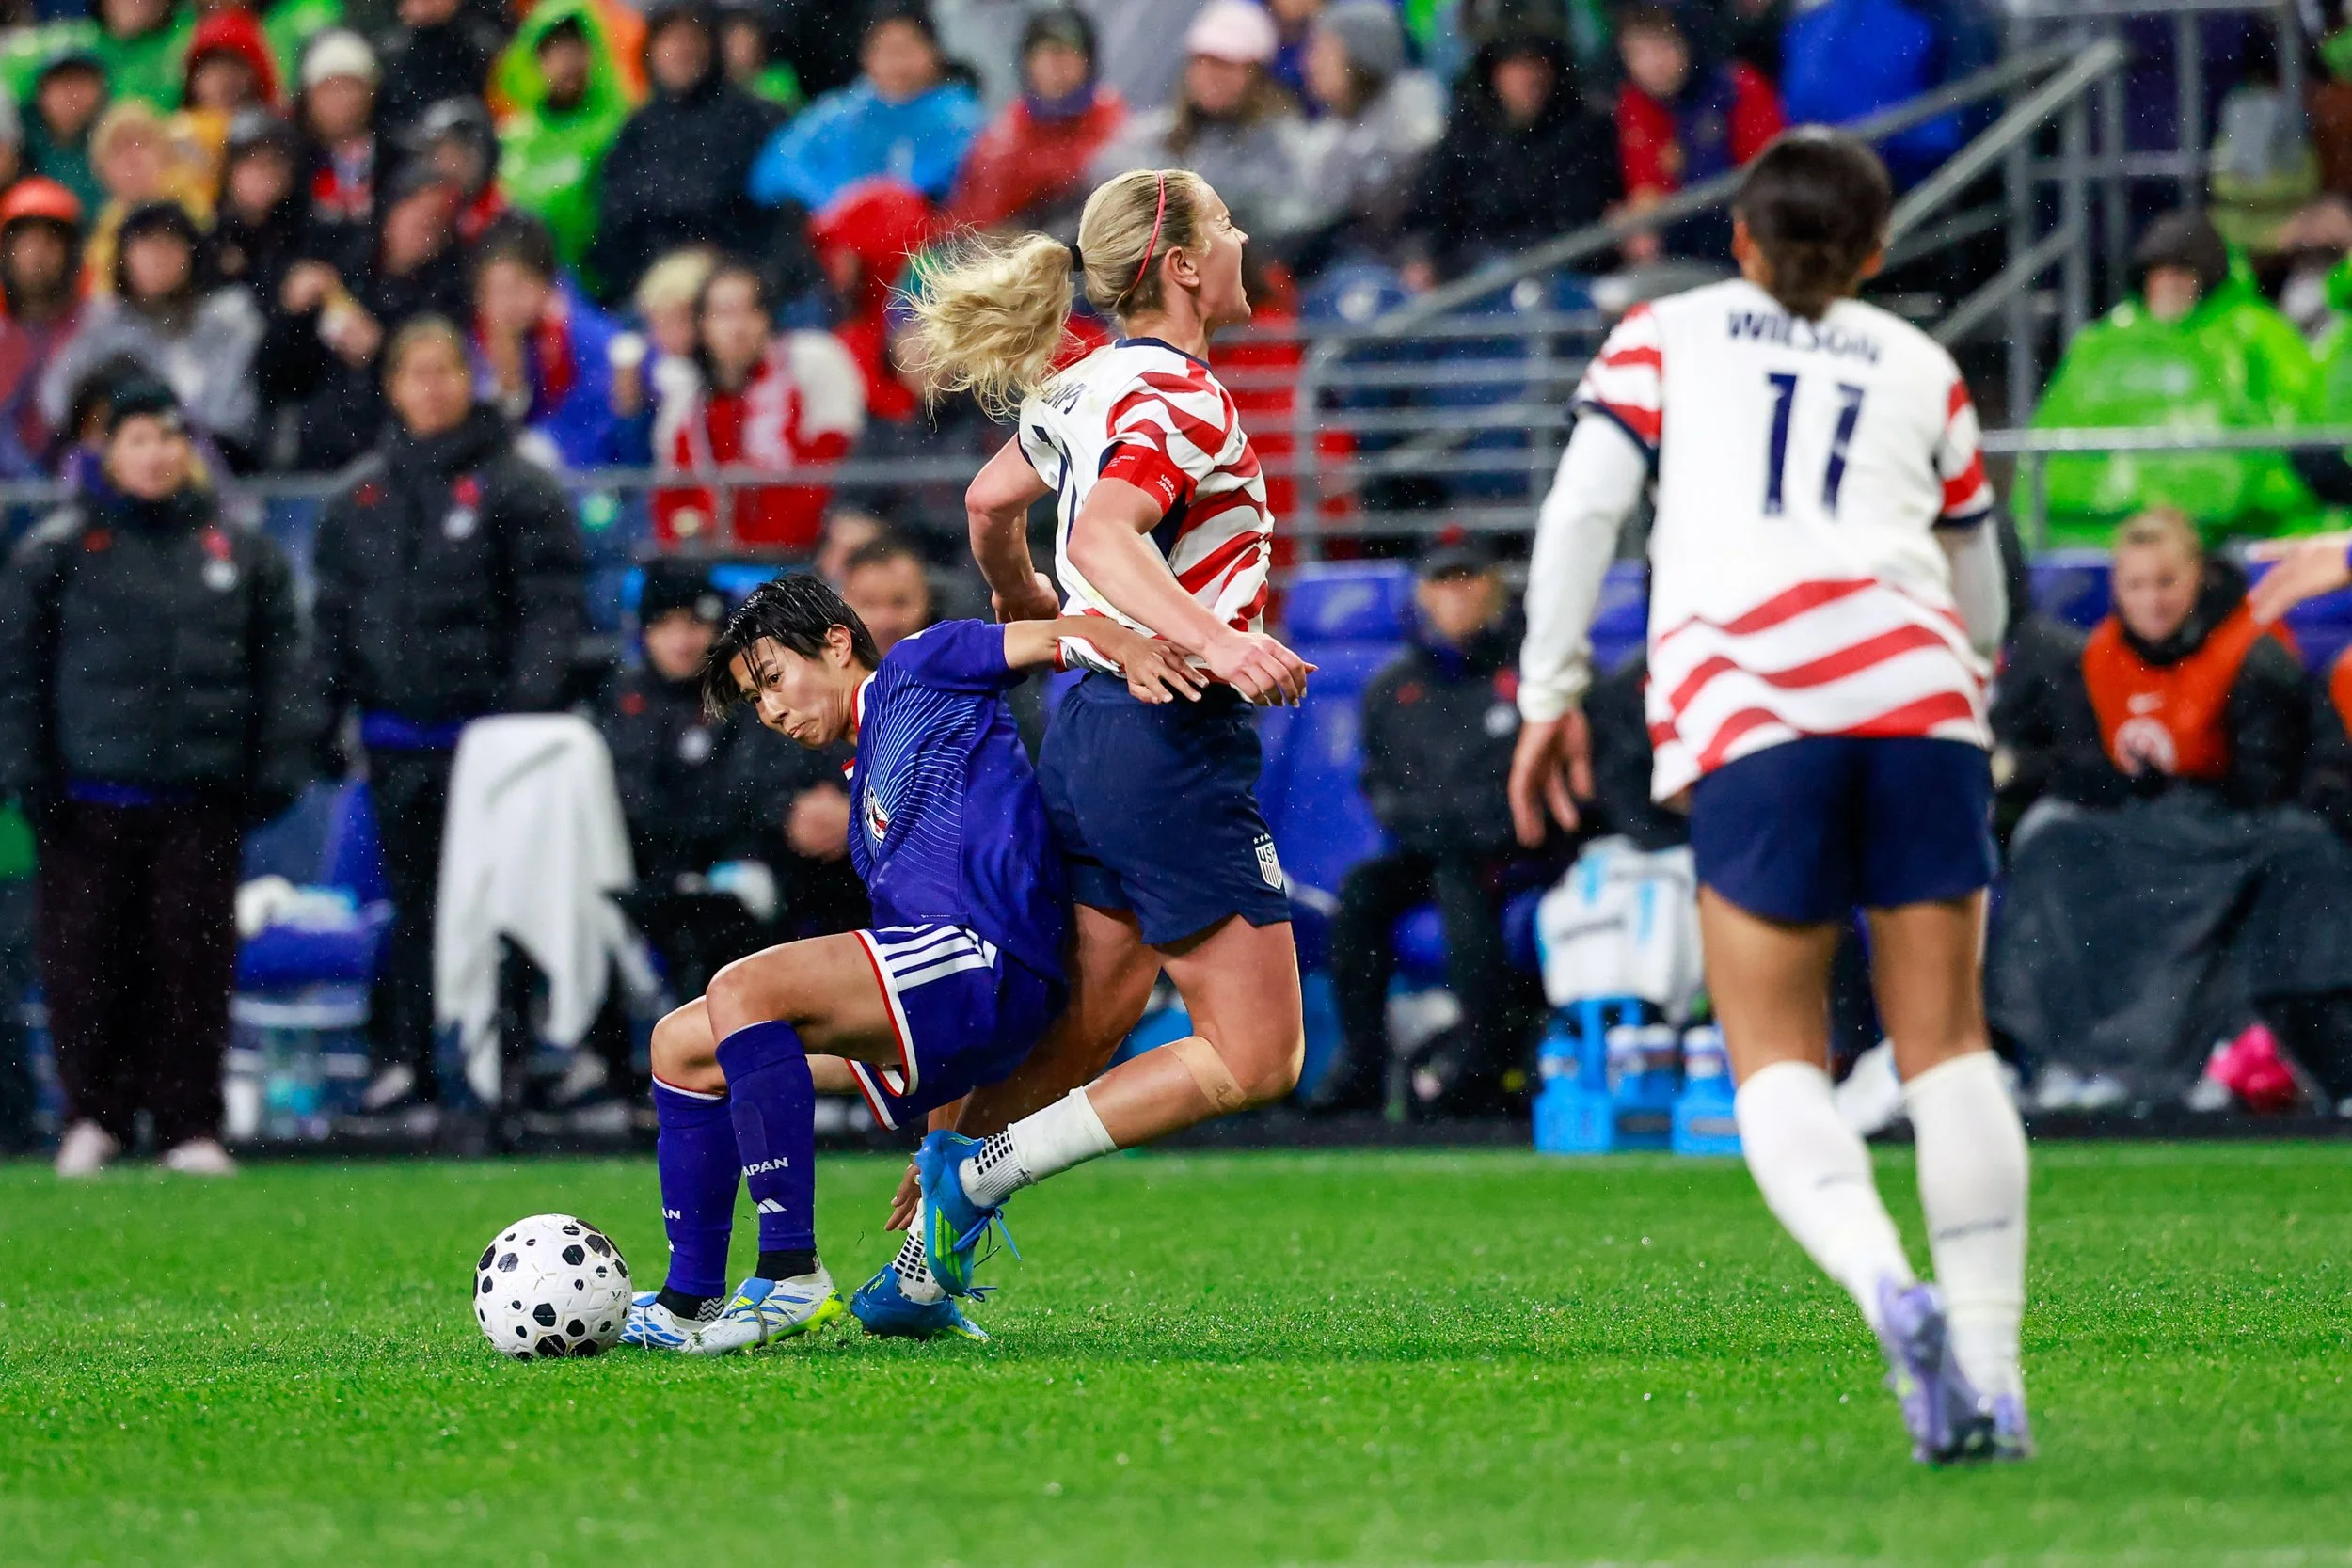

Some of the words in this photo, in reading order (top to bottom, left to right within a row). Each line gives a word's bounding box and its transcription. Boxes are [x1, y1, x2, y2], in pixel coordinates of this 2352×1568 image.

[1728, 311, 1881, 363] WILSON
[1762, 372, 1866, 520] 11
[1160, 474, 1175, 490] USA
[743, 1156, 789, 1177] APAN
